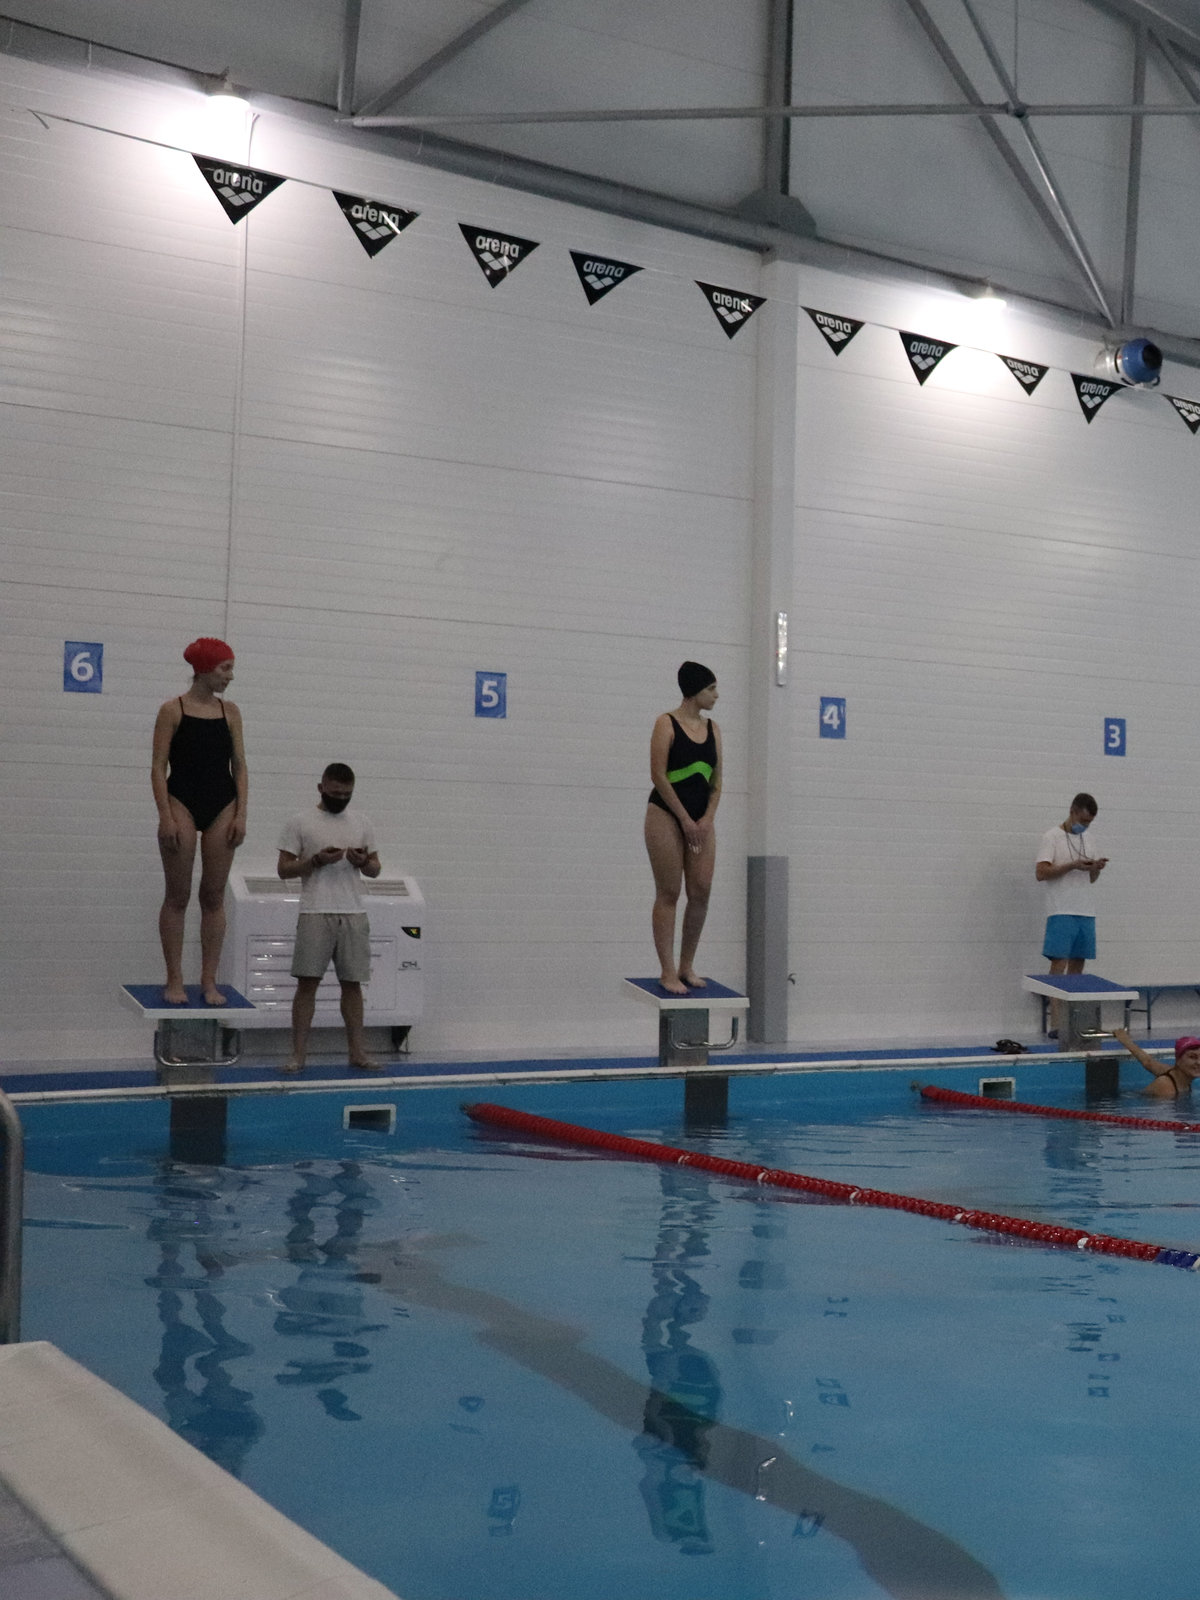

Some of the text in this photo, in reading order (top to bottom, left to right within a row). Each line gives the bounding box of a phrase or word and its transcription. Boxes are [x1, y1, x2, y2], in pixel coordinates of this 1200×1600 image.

[213, 168, 264, 194] arena
[351, 204, 400, 227] arena
[475, 235, 520, 259] arena
[583, 260, 625, 278] arena
[816, 312, 852, 333] arena
[910, 340, 943, 357] arena
[1006, 358, 1039, 377] arena
[1080, 381, 1110, 396] arena
[71, 652, 93, 681] 6
[482, 680, 498, 707] 5
[823, 705, 840, 729] 4
[1108, 725, 1120, 747] 3
